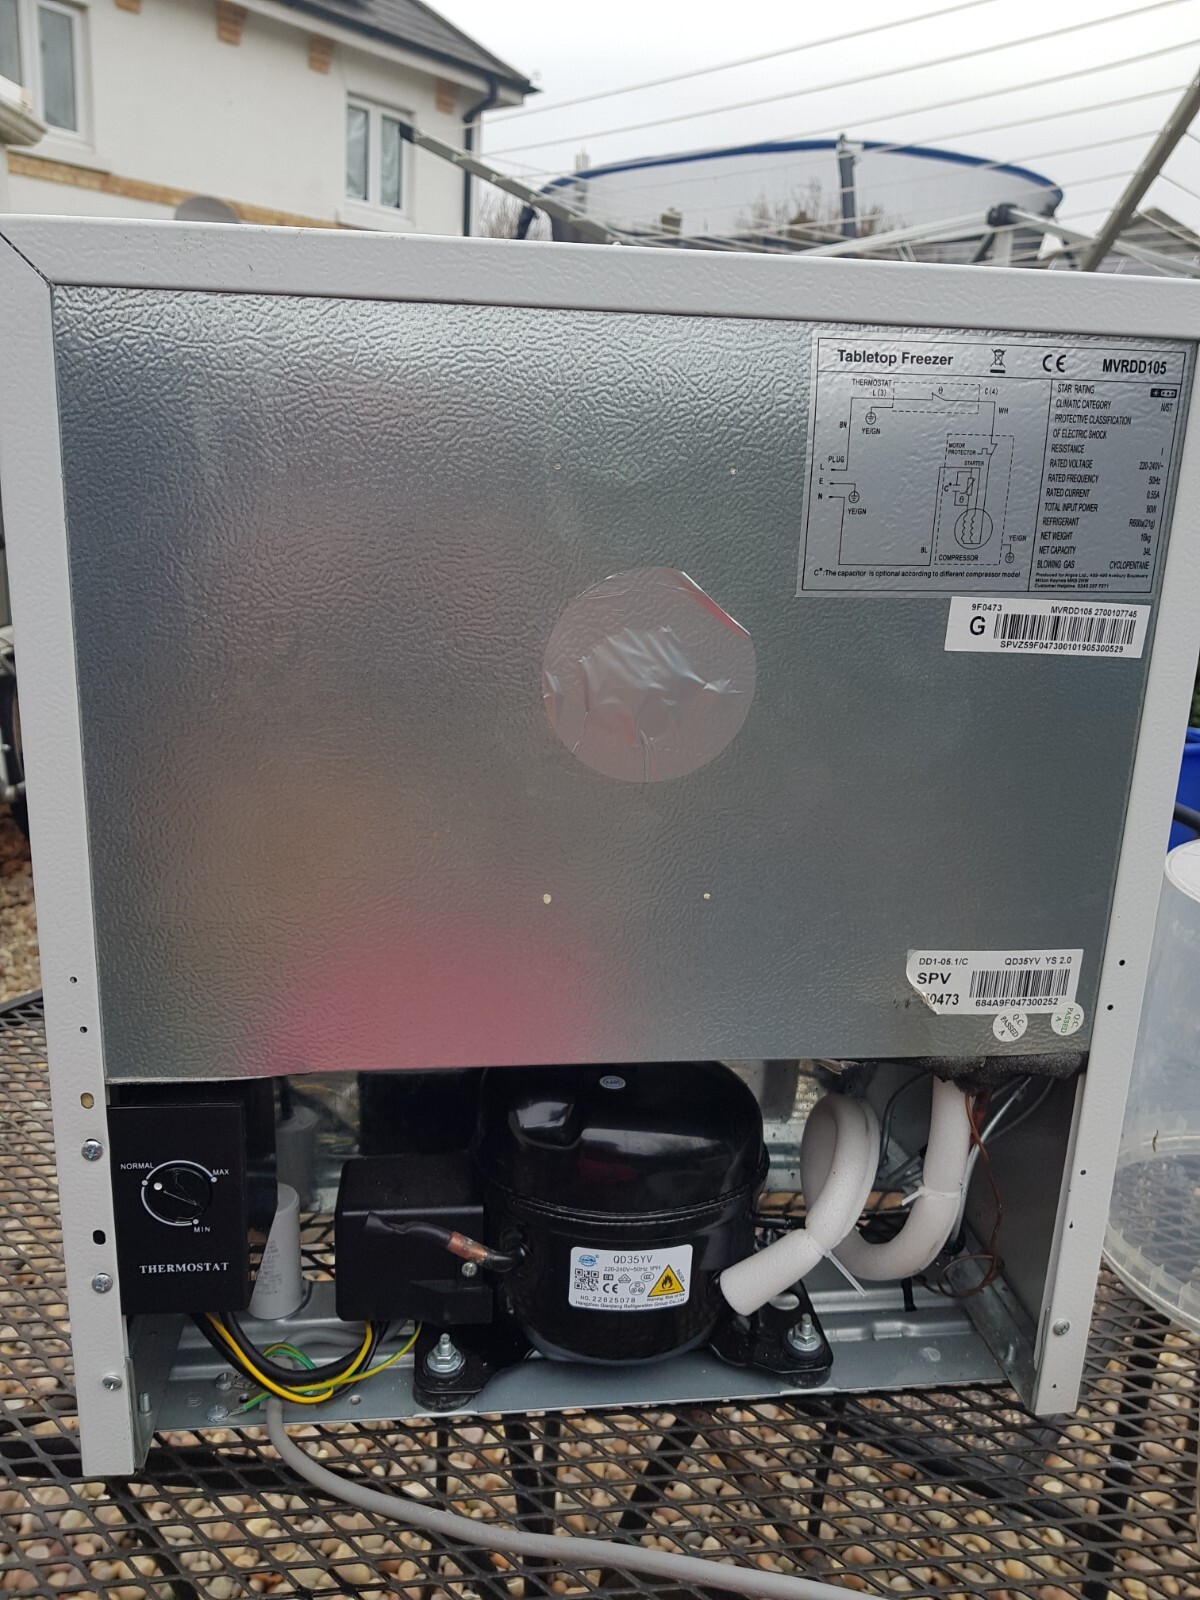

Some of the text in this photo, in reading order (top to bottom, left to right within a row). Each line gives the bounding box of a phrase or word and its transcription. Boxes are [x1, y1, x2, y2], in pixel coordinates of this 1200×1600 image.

[837, 349, 954, 366] Tabletop Freezer
[1102, 358, 1167, 374] MVRDD105
[852, 378, 892, 387] THERMOSTAT
[1057, 384, 1095, 394] STAR RATING
[1056, 399, 1112, 410] CLIMATIC CATEGORY
[839, 421, 848, 429] BN
[1054, 414, 1132, 426] PROTECTIVE CLASSIFICATION
[862, 427, 881, 435] YE/GN
[1052, 429, 1108, 440] OF ELECTRIC SHOCK
[1051, 443, 1085, 453] RESISTANCE
[827, 455, 845, 463] PLUG
[1049, 458, 1094, 468] RATED VOLTAGE
[819, 463, 824, 471] L
[818, 477, 824, 485] E
[1047, 473, 1099, 484] RATED FREQUENCY
[1148, 475, 1161, 485] 50Hz
[817, 492, 823, 500] N
[1046, 488, 1091, 498] RATED CURRENT
[848, 508, 867, 516] YE/GN
[1044, 502, 1098, 513] TOTAL INPUT POWER
[1042, 516, 1080, 526] REFRIGERANT
[1008, 534, 1027, 542] YE/GN
[1040, 531, 1073, 541] NET WEIGHT
[1038, 545, 1076, 555] NET CAPACITY
[938, 554, 979, 562] COMPRESSOR
[1036, 559, 1075, 569] BLOWING GAS
[1109, 560, 1150, 570] CYCLOPENTANE
[837, 570, 866, 579] capacitor
[875, 570, 900, 578] optional
[900, 571, 932, 579] according
[971, 603, 1003, 612] 9F0473
[1050, 606, 1138, 618] MVRDD105 2700107745
[969, 615, 986, 636] G
[918, 957, 969, 966] DD1-05.1/C
[1004, 956, 1072, 966] QD35YV YS 2.0
[916, 971, 952, 985] SPV
[926, 992, 960, 1006] 0473
[975, 997, 1059, 1007] 684A9F047300252
[1060, 1006, 1074, 1034] PASSED
[1000, 1015, 1019, 1038] PASSED
[120, 1162, 155, 1170] NORMAL
[613, 1254, 653, 1264] QD35YV
[139, 1261, 229, 1274] THERMOSTAT
